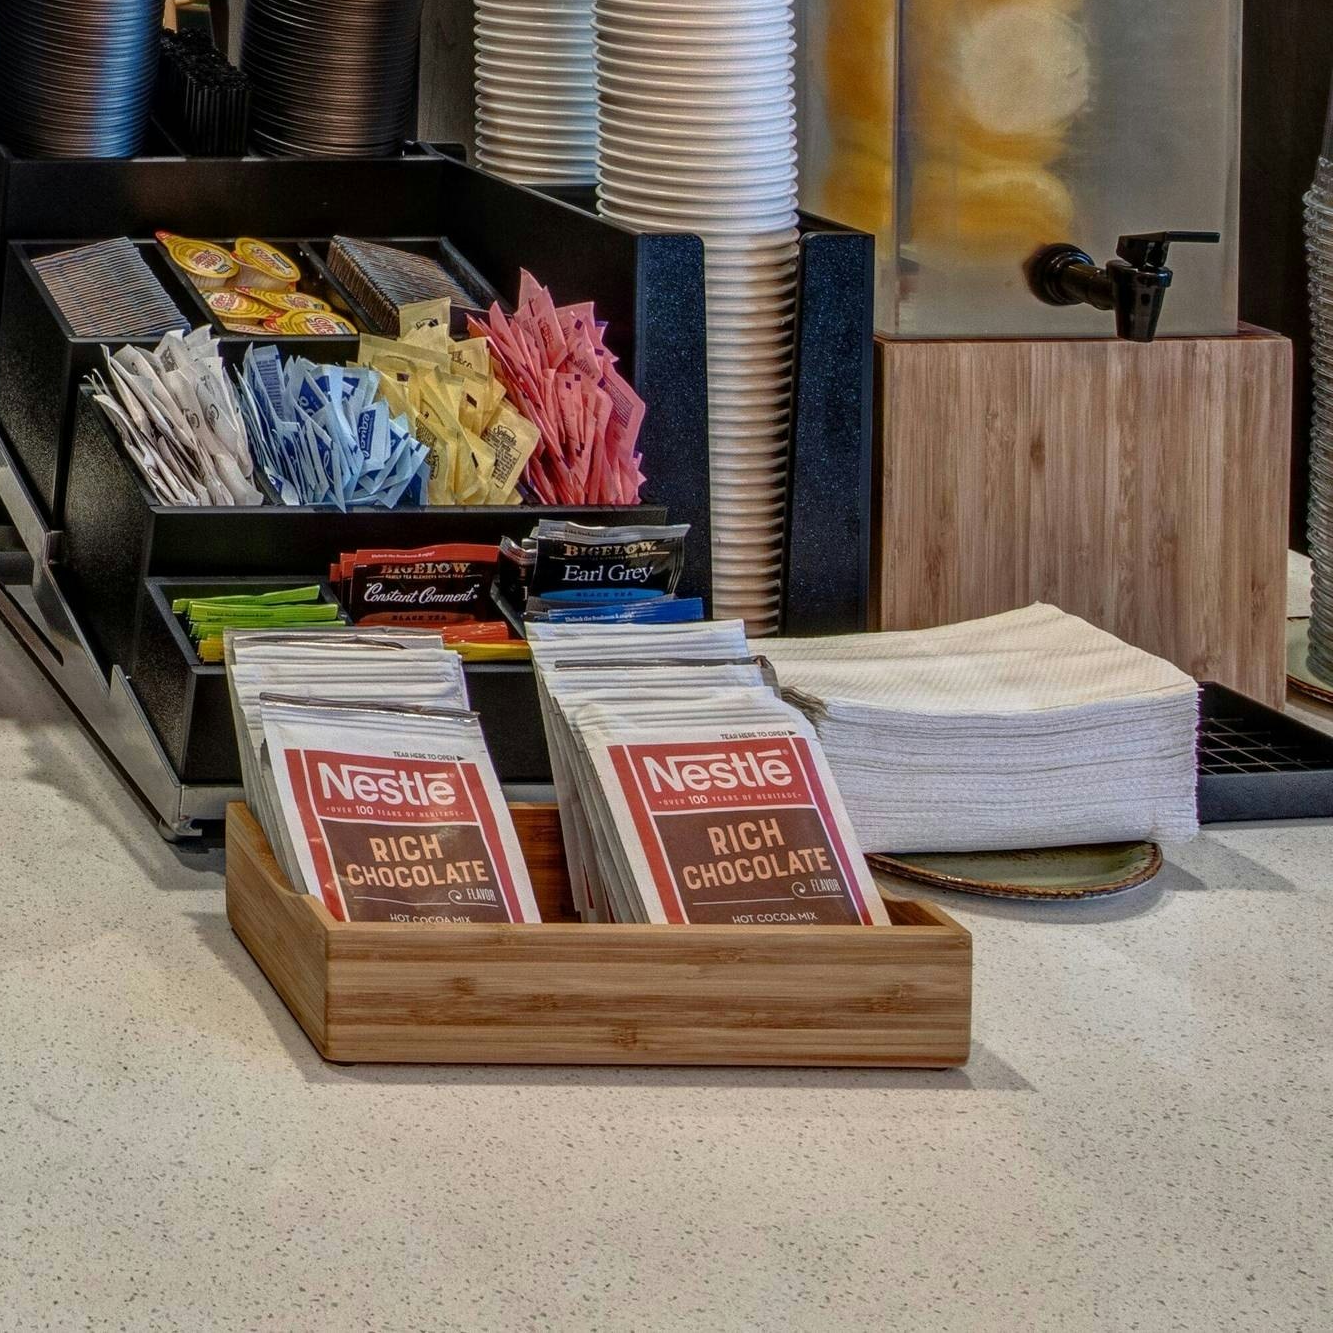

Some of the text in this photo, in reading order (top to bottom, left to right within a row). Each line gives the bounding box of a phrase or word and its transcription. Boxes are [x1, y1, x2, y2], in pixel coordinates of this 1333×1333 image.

[563, 540, 657, 557] BIGELOW
[380, 562, 471, 574] BIGELOW
[562, 564, 654, 583] Earl Grey
[720, 732, 739, 740] TEAR
[757, 730, 767, 738] TO
[393, 751, 456, 762] TEAR HERE TO OPEN
[688, 794, 709, 804] 100
[712, 794, 739, 802] YEARS
[355, 804, 374, 816] 100
[707, 817, 786, 856] RICH
[368, 833, 444, 863] RICH
[345, 860, 490, 889] CHOCOLATE
[682, 847, 832, 890] CHOCOLATE
[809, 878, 842, 893] FLAVOR
[466, 888, 496, 902] FLAVOR
[389, 913, 471, 924] HOT COCOA MIX
[732, 911, 818, 924] HOT COCOA MIX
